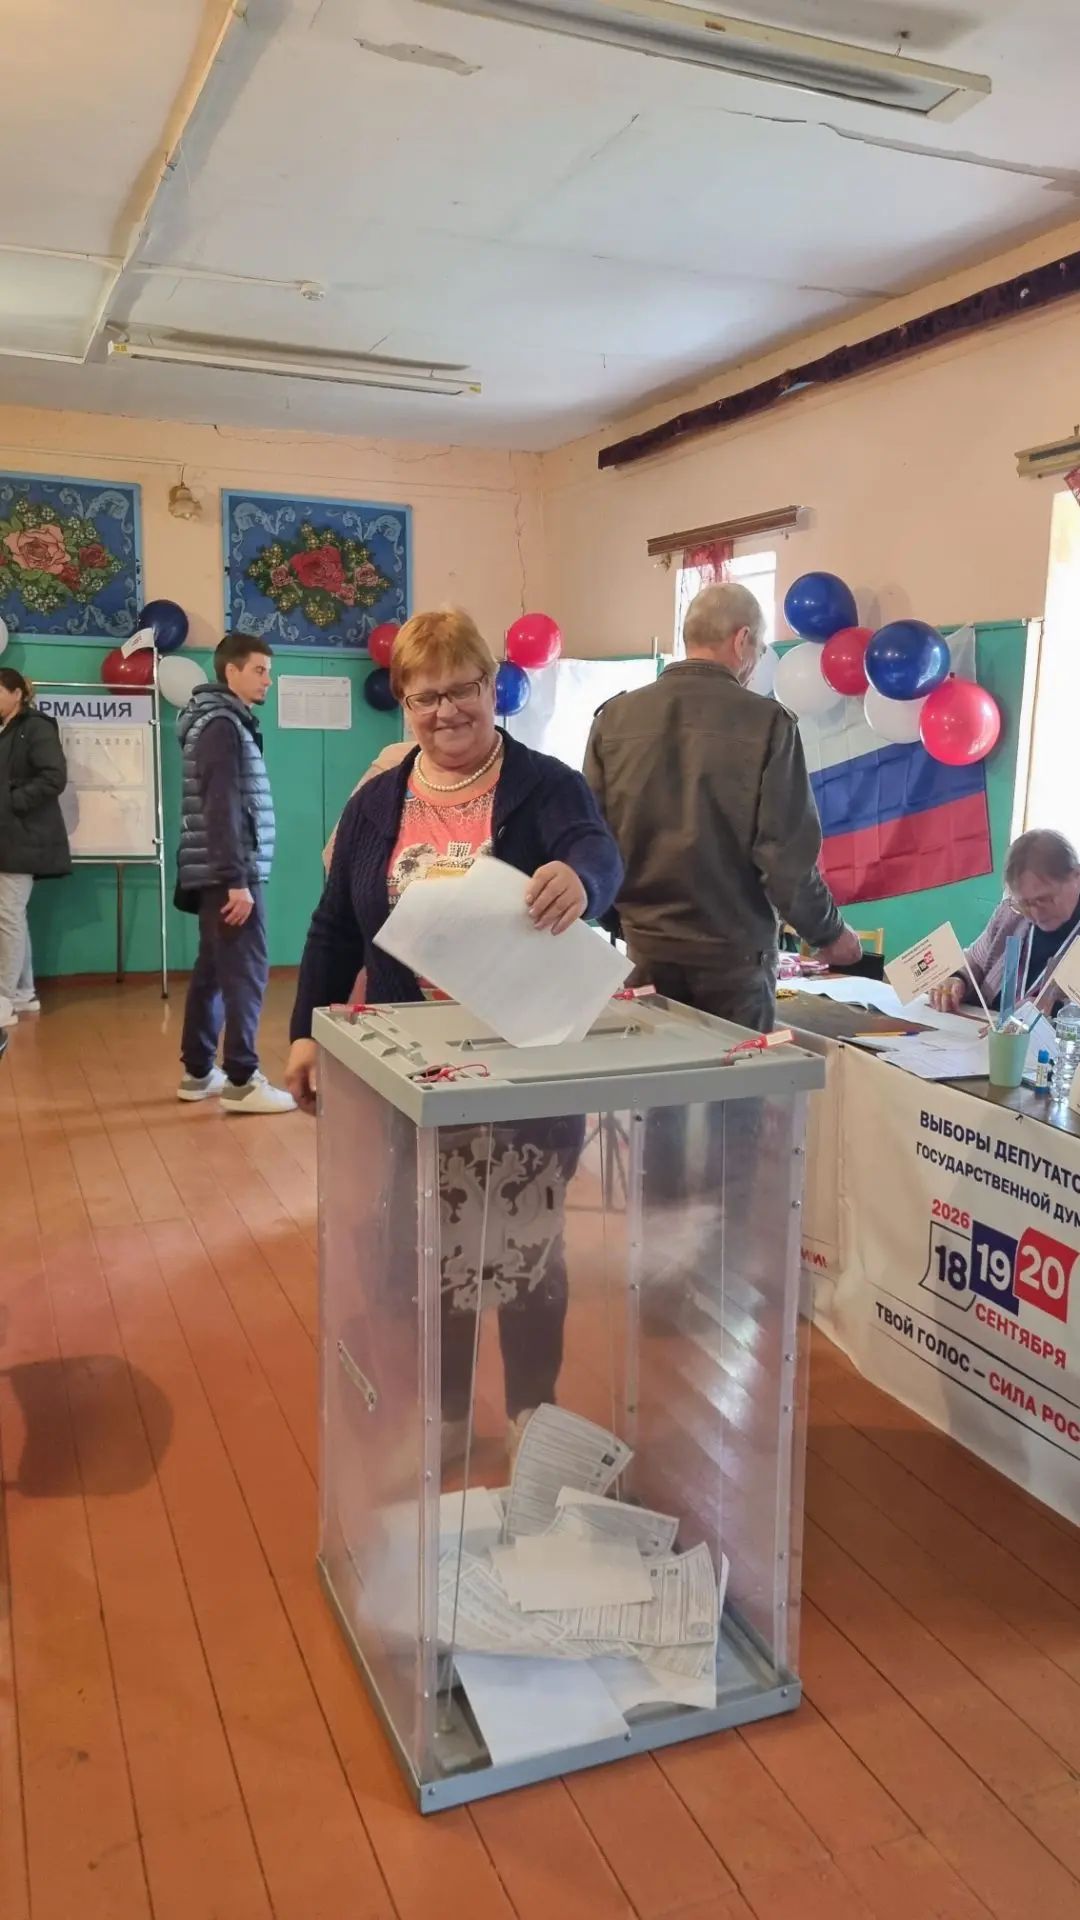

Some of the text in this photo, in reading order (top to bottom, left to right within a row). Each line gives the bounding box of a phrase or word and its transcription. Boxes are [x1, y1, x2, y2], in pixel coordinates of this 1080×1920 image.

[35, 701, 132, 720] РМАЦИЯ
[916, 1141, 1050, 1214] ГОСУДАРСТВЕННОЙ
[920, 1110, 1080, 1194] ВЫБОРЫ ДЕПУТАТО
[931, 1199, 971, 1230] 2026
[935, 1243, 1065, 1300] 18 19 20
[975, 1303, 1066, 1370] СЕНТЯБРЯ
[876, 1301, 913, 1339] ТВОЙ
[917, 1327, 970, 1373] ГОЛОС
[989, 1372, 1037, 1417] СИЛА
[1042, 1404, 1080, 1442] РОС
